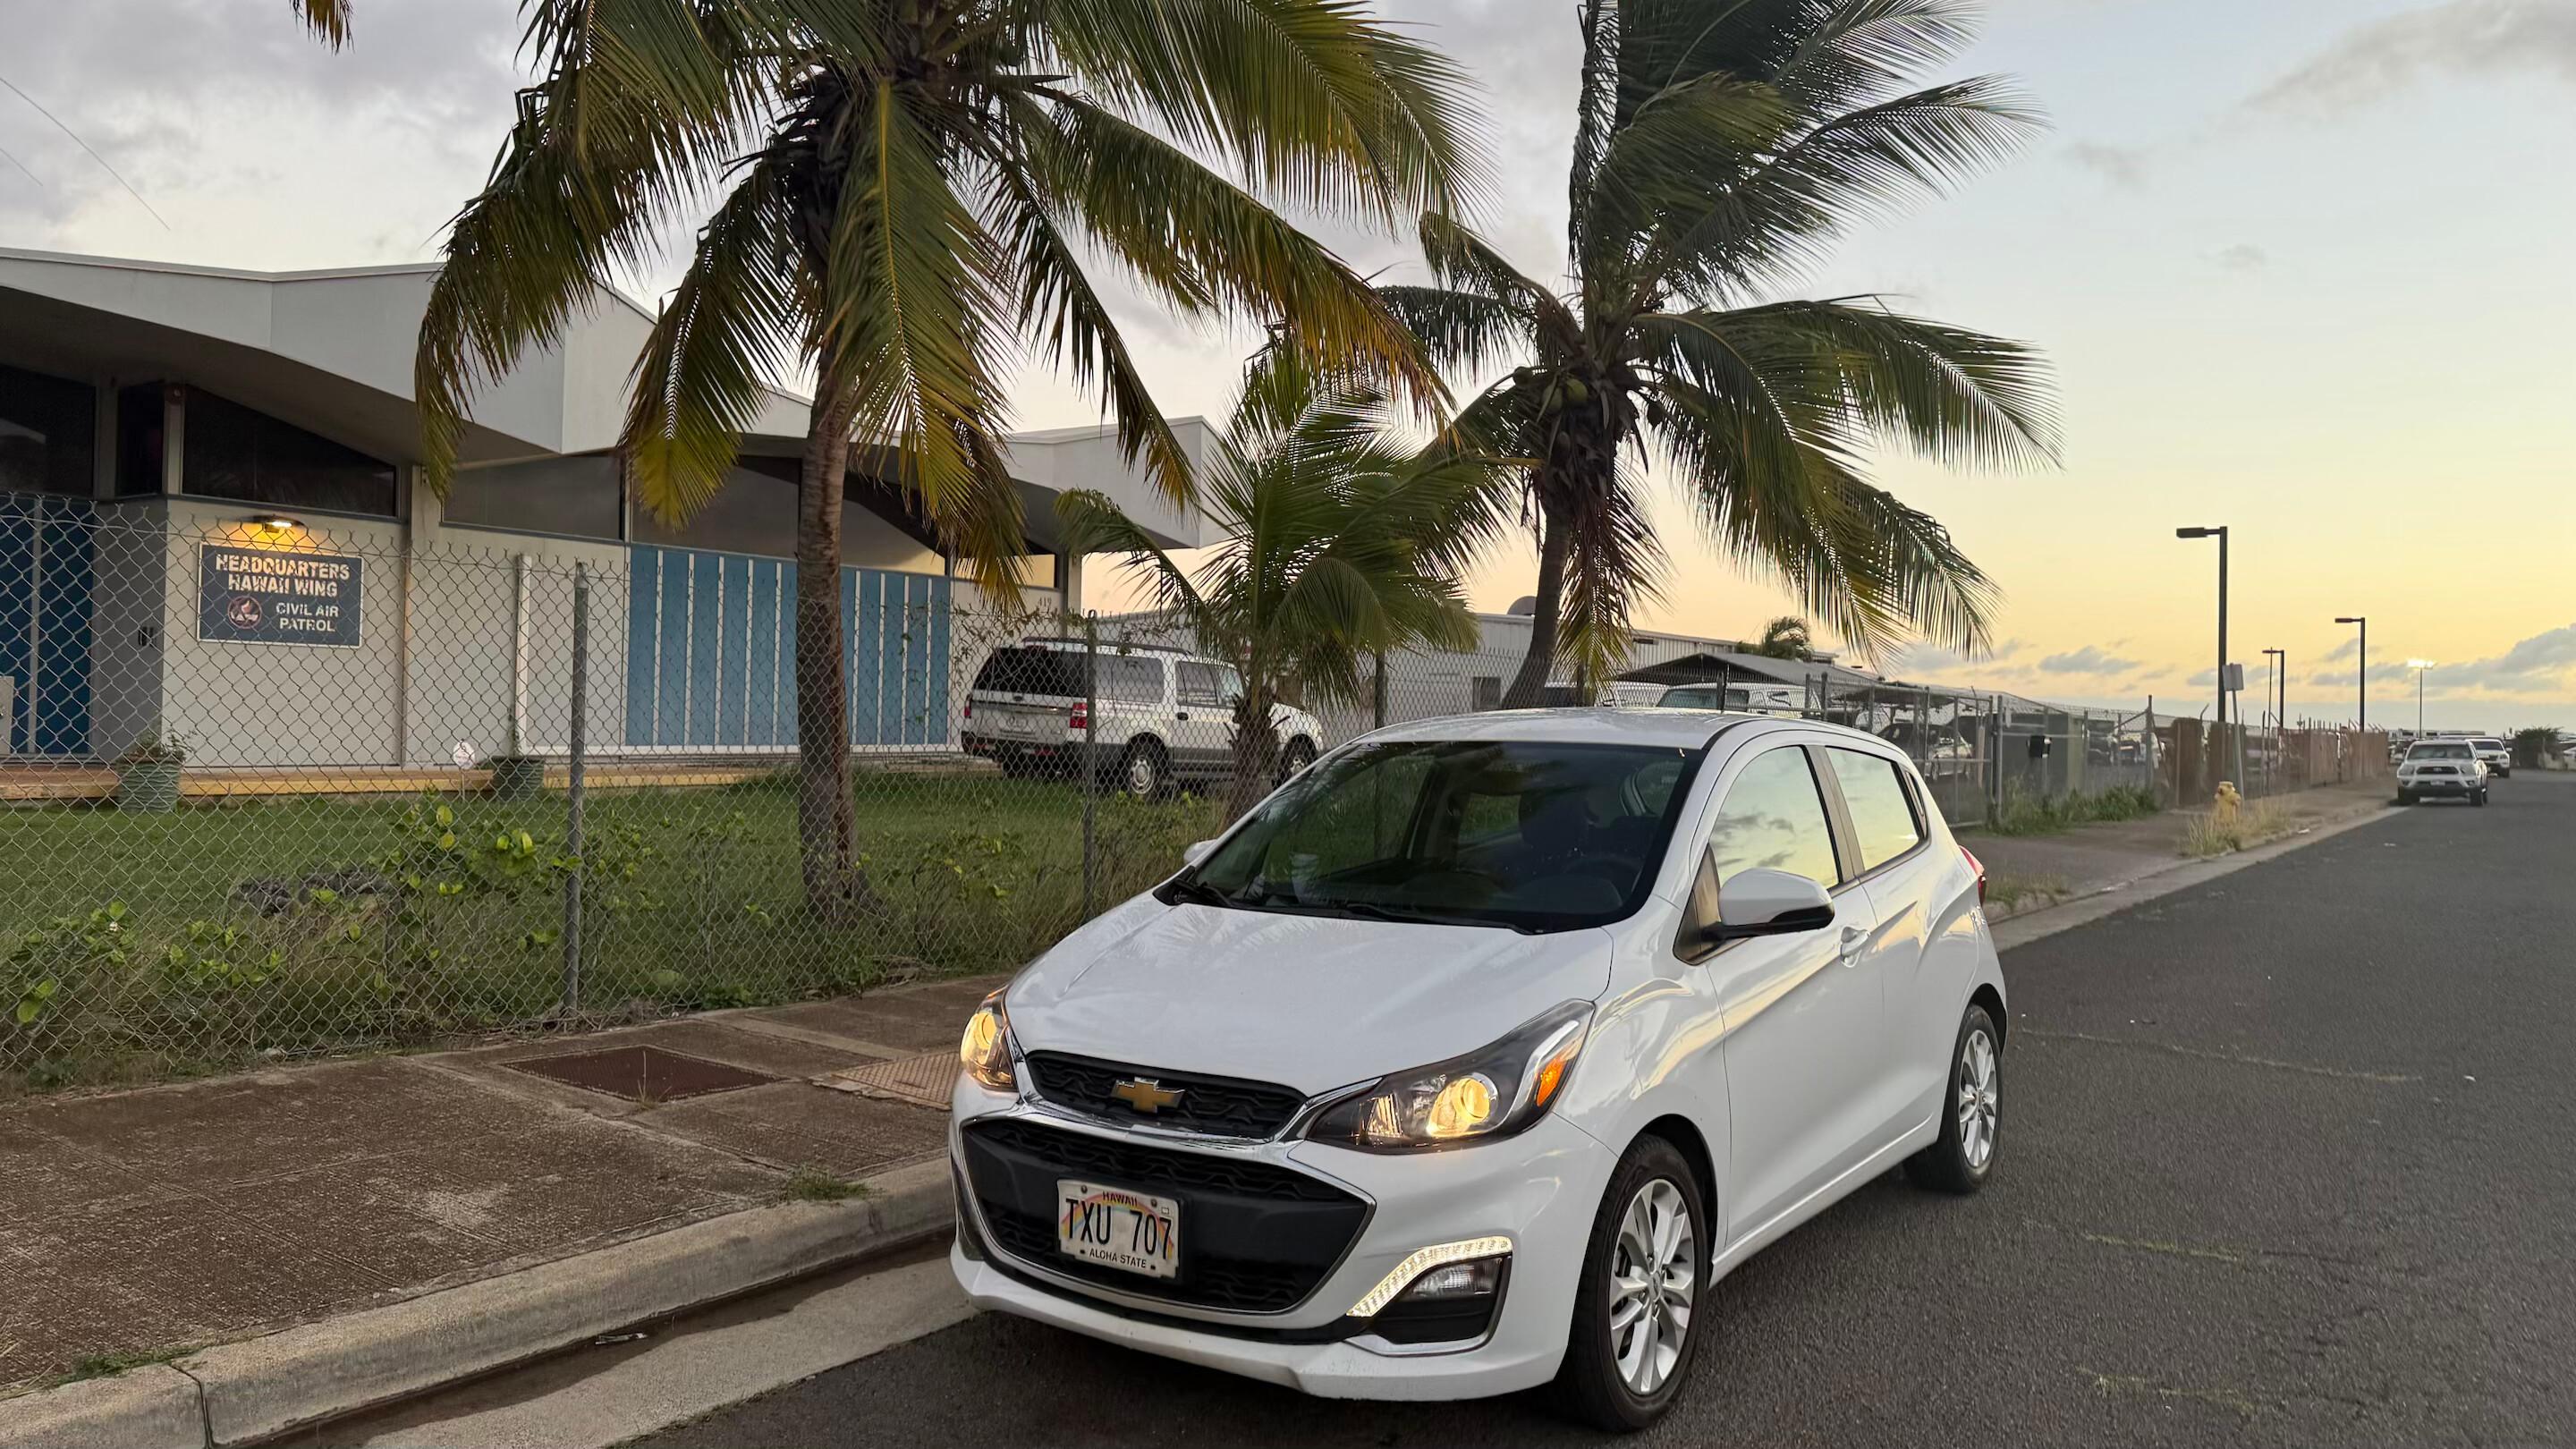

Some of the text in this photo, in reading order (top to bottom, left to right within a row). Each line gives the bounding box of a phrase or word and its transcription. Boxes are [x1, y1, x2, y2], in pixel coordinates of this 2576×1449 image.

[216, 555, 350, 580] HEADQUARTERS
[228, 573, 338, 597] HAWAII WING
[275, 602, 339, 618] CIVIL AIR
[279, 619, 335, 631] PATROL
[1102, 1191, 1138, 1207] HAWAII
[1065, 1198, 1172, 1260] TXU 707
[1089, 1248, 1147, 1268] ALOHA STATE
